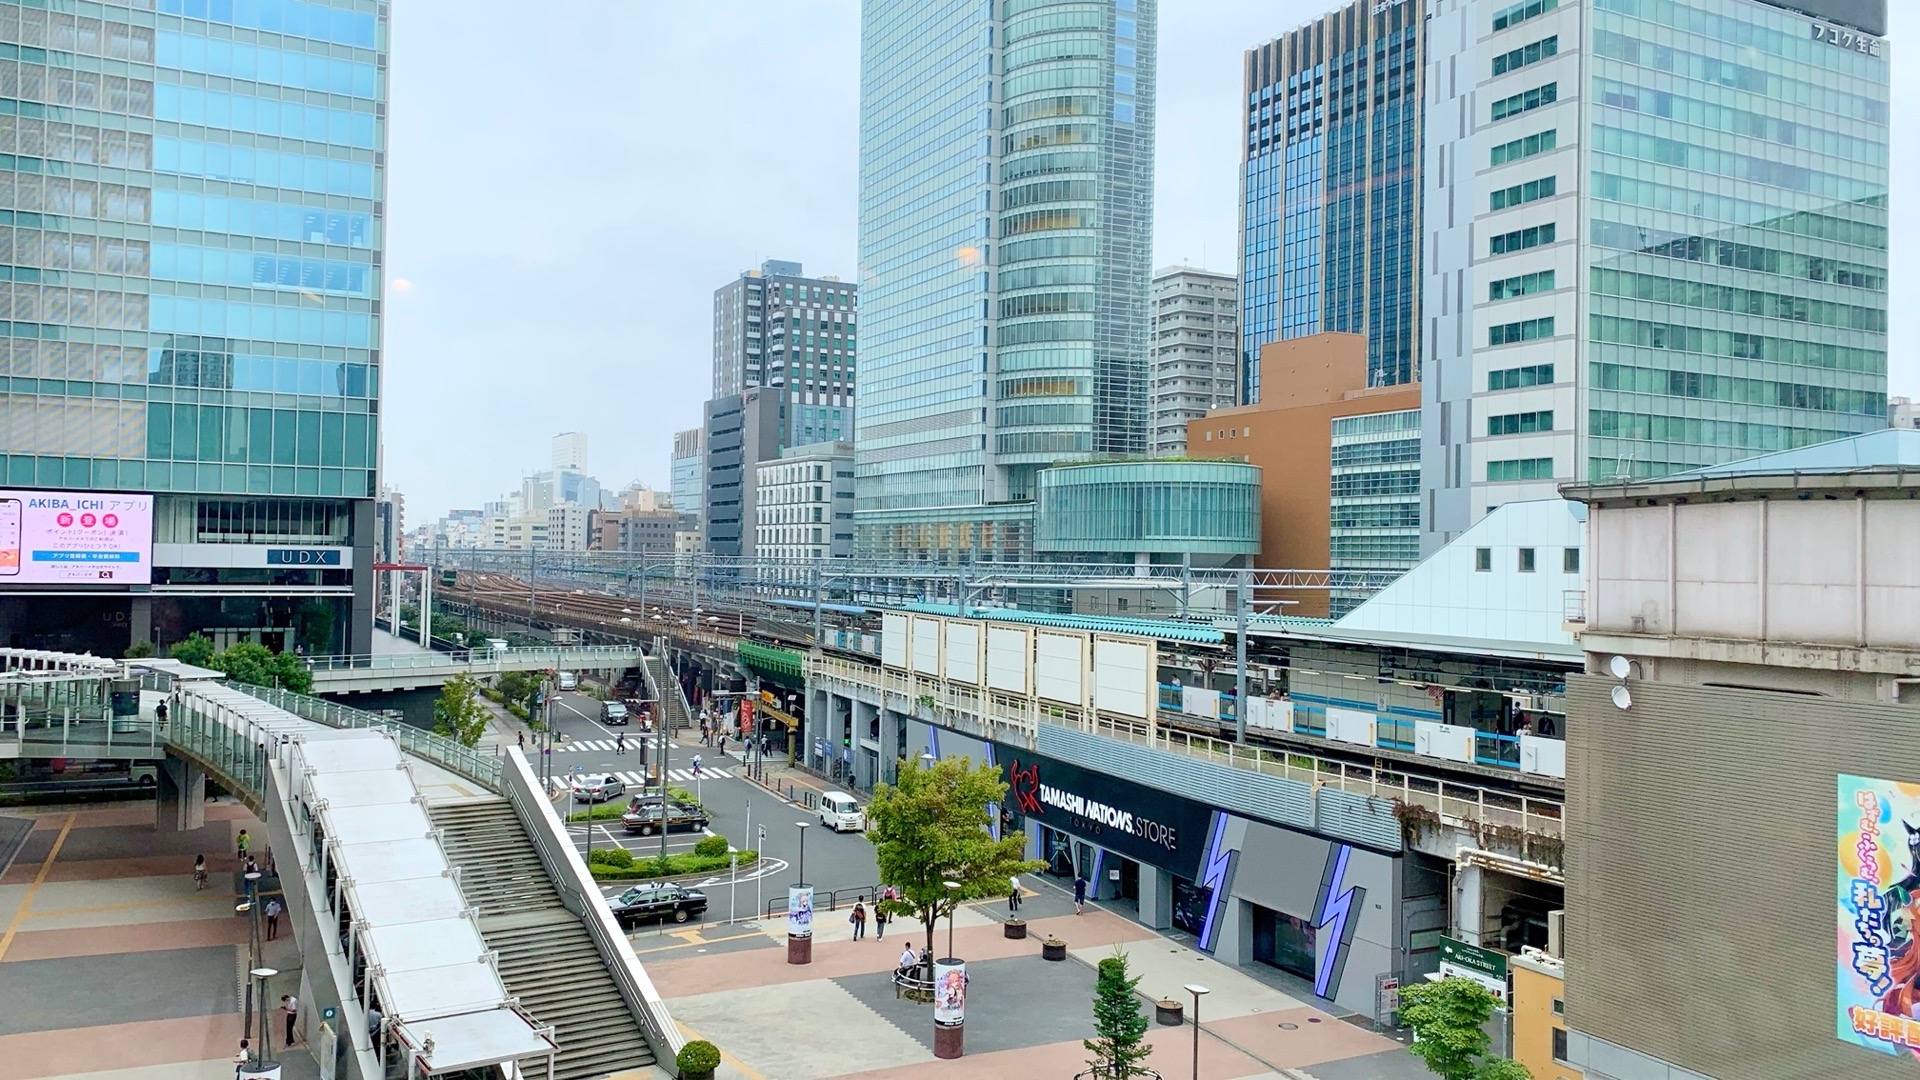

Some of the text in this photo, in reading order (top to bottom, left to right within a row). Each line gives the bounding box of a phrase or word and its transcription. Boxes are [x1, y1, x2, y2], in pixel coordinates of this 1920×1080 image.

[1814, 24, 1880, 56] フコク生命
[28, 498, 148, 512] AKIBA_ICHI アプリ
[58, 514, 117, 526] 新登場
[282, 550, 326, 564] UDX
[102, 611, 132, 622] UD
[1040, 783, 1085, 816] TAMASHII
[1136, 816, 1177, 851] STORE
[1069, 816, 1101, 835] TOKYO
